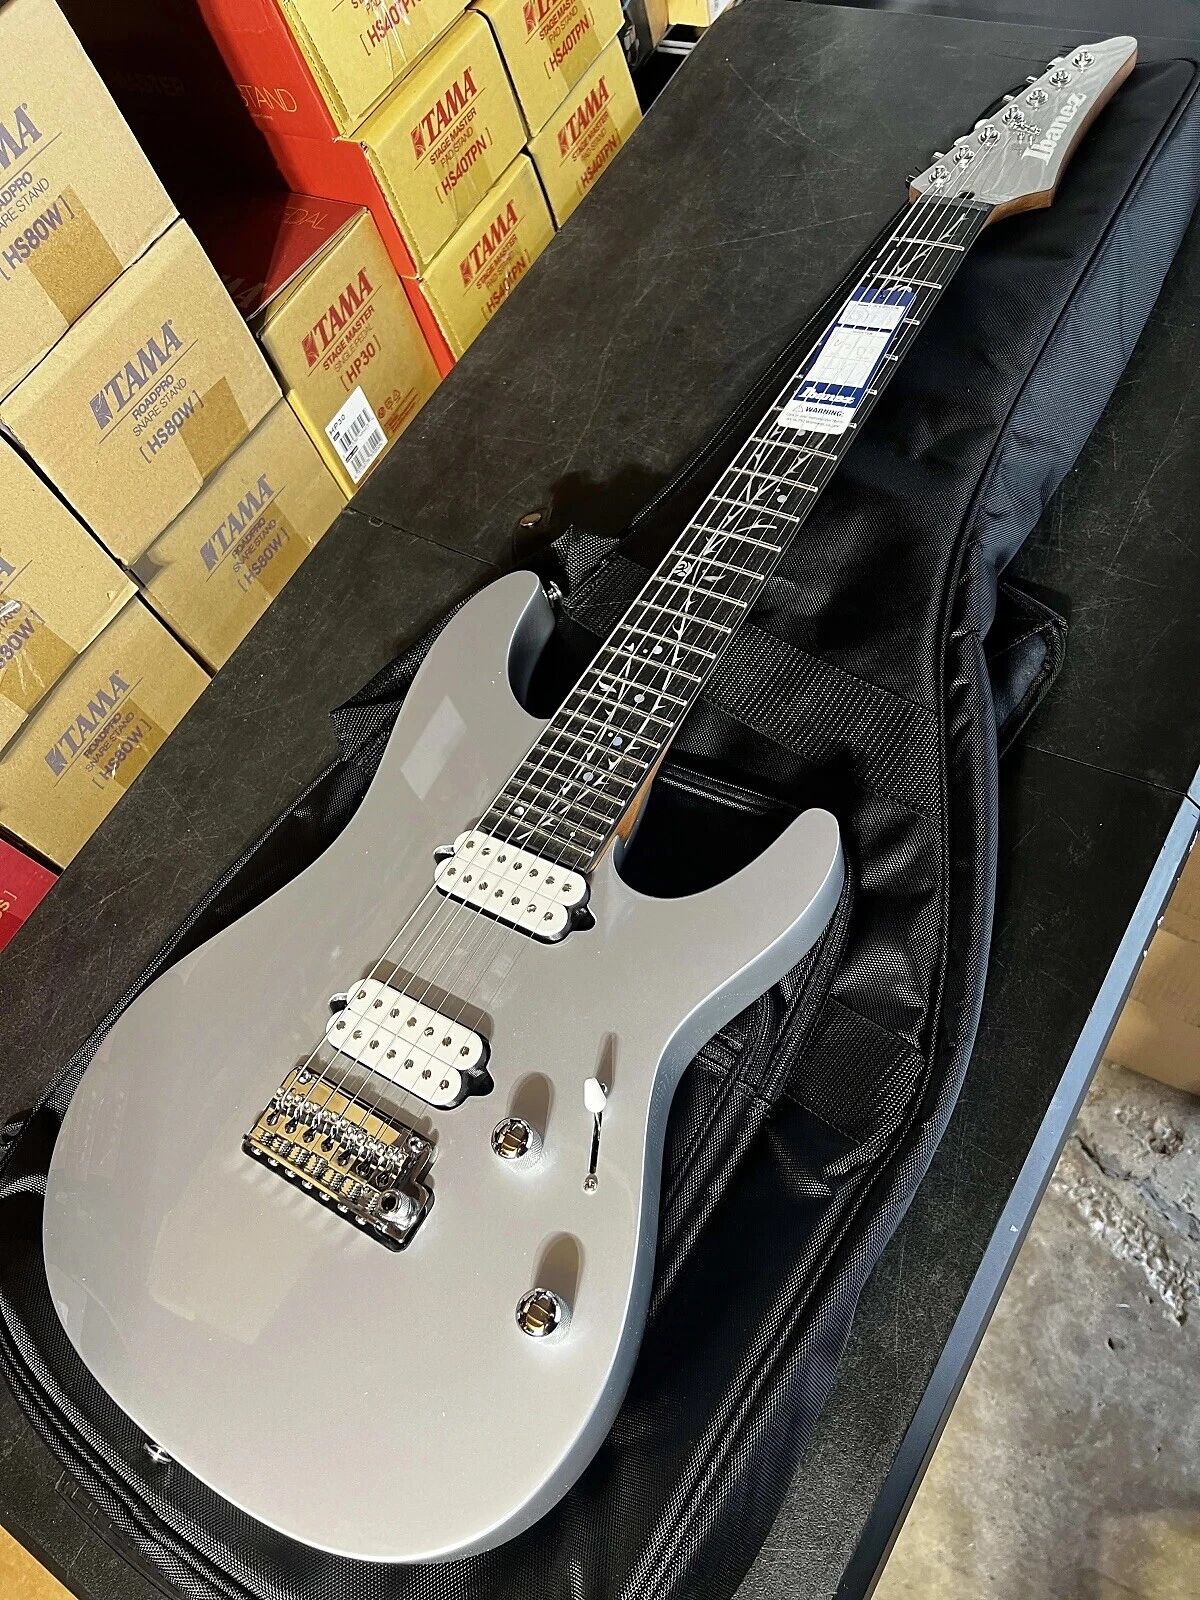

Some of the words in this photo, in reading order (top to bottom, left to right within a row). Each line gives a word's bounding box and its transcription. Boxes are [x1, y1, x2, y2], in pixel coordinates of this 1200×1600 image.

[539, 14, 557, 40] STAGE
[421, 67, 477, 147] TAMA
[429, 137, 451, 165] STAGE
[449, 107, 477, 146] MASTER
[566, 76, 609, 146] TAMA
[1021, 92, 1087, 167] Ibanez
[454, 126, 473, 153] STAND
[16, 177, 50, 213] STAND
[469, 200, 518, 275] TAMA
[312, 267, 373, 352] TAMA
[323, 341, 347, 370] STAGE
[345, 304, 375, 343] MASTER
[104, 321, 183, 412] TAMA
[131, 374, 174, 420] ROADPRO
[133, 406, 161, 437] SNARE
[160, 377, 187, 409] STAND
[328, 413, 346, 437] HP30
[209, 474, 275, 555] TAMA
[233, 544, 256, 573] SNARE
[58, 671, 131, 759] TAMA
[86, 741, 112, 773] SNARE
